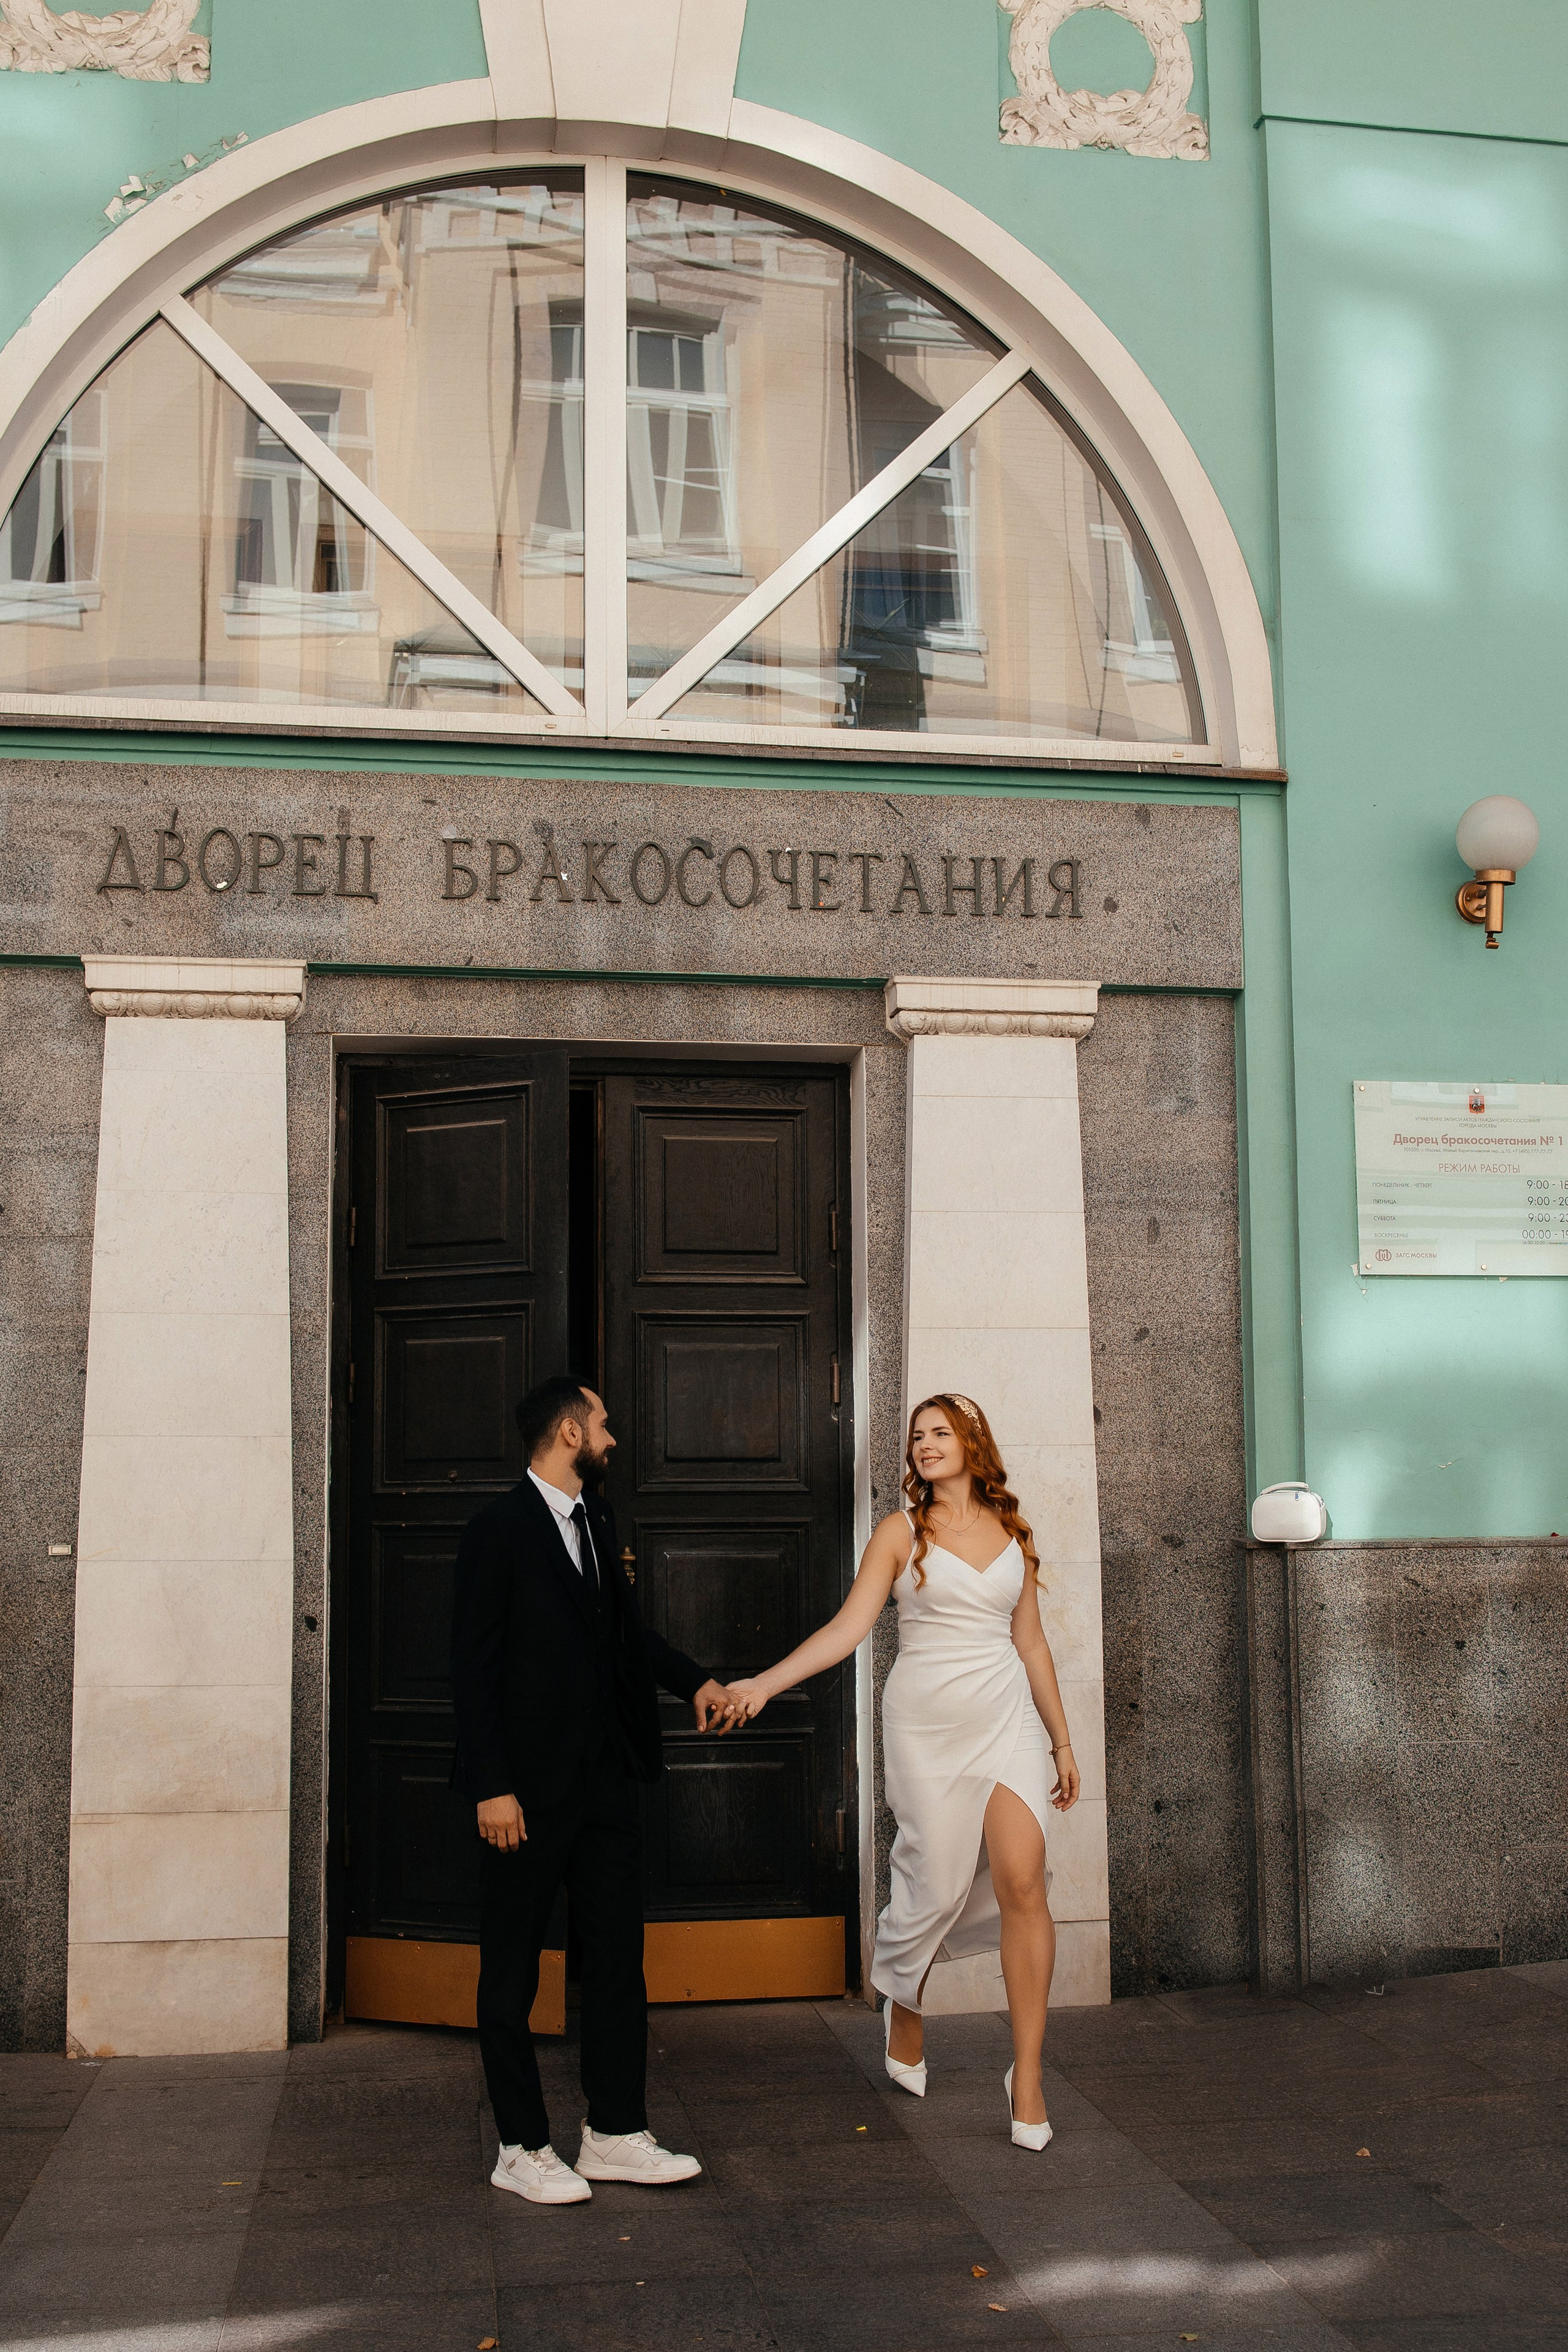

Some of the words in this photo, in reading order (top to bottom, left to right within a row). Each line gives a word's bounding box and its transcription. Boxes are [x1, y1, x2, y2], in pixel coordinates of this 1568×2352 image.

[97, 826, 378, 903] ДВОРЕЦ
[441, 838, 1083, 918] БРАКОСОЧЕТАНИЯ
[1393, 1133, 1438, 1147] Дворец
[1441, 1133, 1536, 1147] бракосочетания
[1540, 1136, 1554, 1145] №
[1558, 1136, 1562, 1145] 1
[1439, 1163, 1477, 1172] РЕЖИМ
[1480, 1164, 1520, 1173] РАБОТЫ
[1526, 1180, 1549, 1189] 9:00
[1527, 1196, 1550, 1205] 9:00
[1528, 1213, 1550, 1222] 9:00
[1522, 1229, 1551, 1239] 00:00
